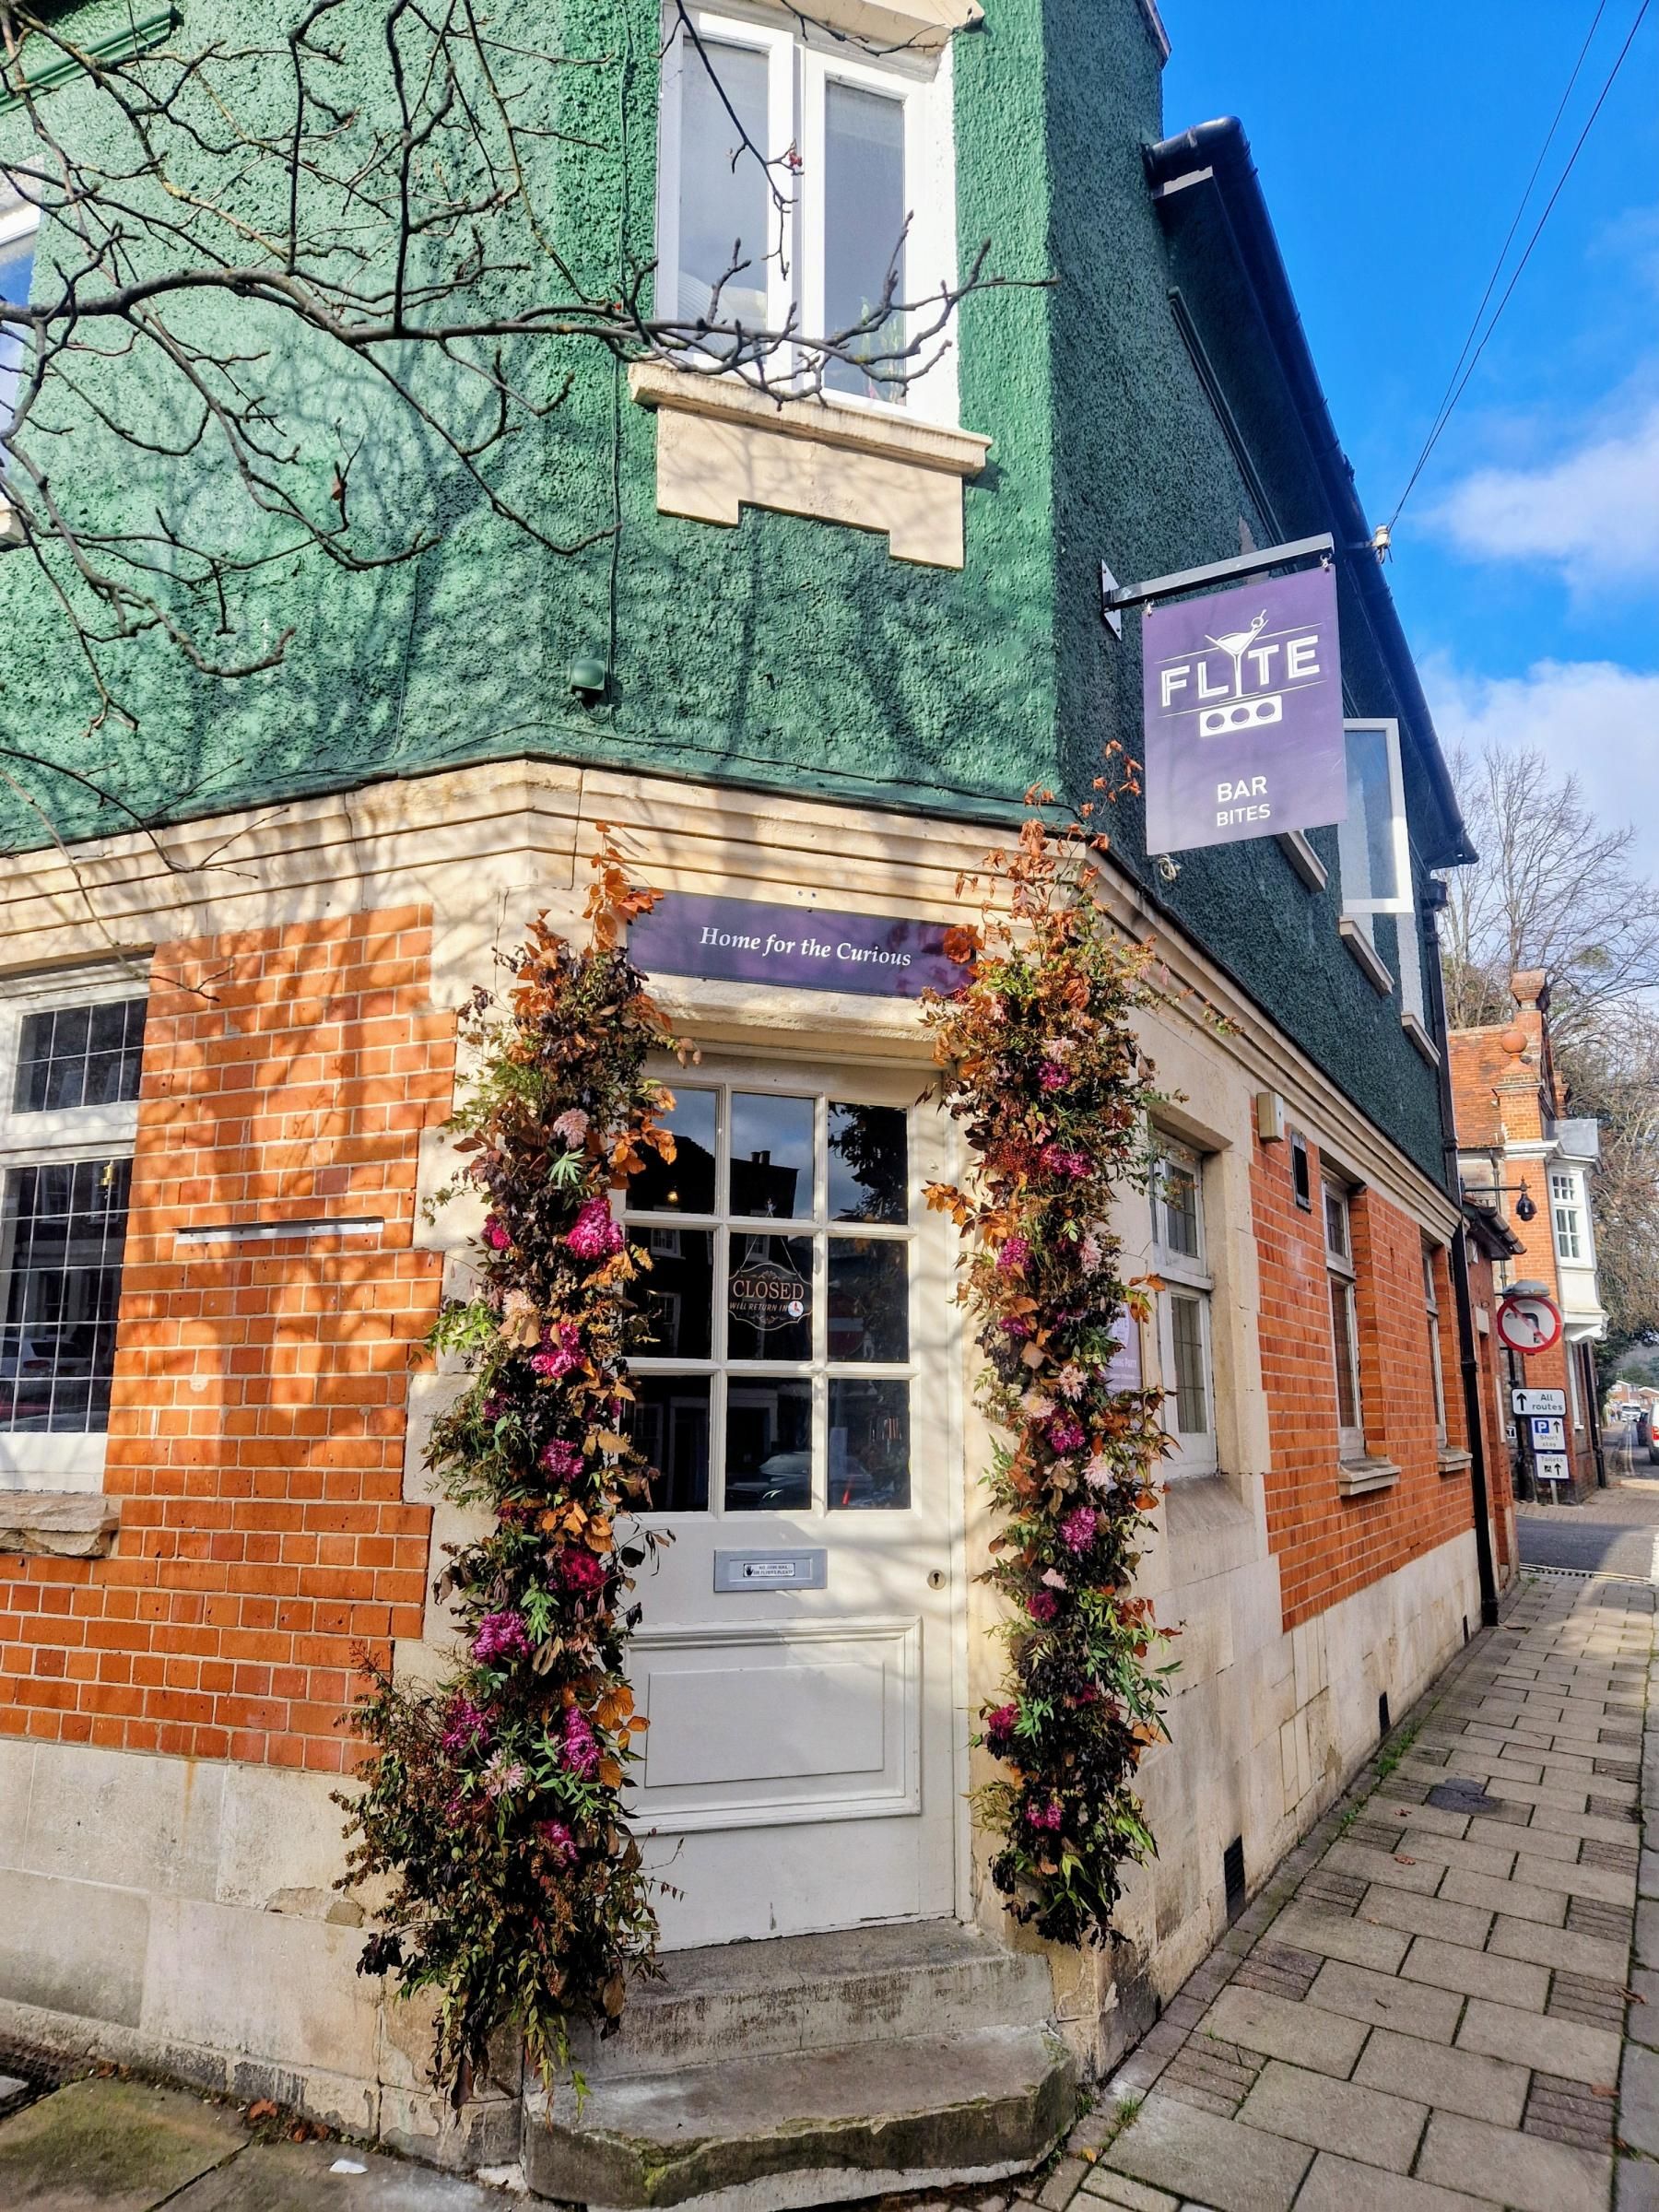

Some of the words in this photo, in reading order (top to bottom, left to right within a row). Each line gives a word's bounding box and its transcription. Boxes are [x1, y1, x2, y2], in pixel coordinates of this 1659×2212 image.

[1160, 620, 1321, 708] FLYTE
[1217, 775, 1268, 803] BAR
[1216, 803, 1271, 827] BITES
[700, 926, 761, 950] Home
[762, 932, 796, 958] for
[800, 938, 831, 959] the
[836, 942, 912, 967] Curious
[733, 1279, 805, 1300] CLOSED
[729, 1301, 747, 1311] WILL
[748, 1302, 778, 1312] RETURN
[779, 1303, 788, 1312] IN
[1532, 1403, 1563, 1411] routes
[1540, 1394, 1553, 1402] All
[1537, 1421, 1547, 1433] P
